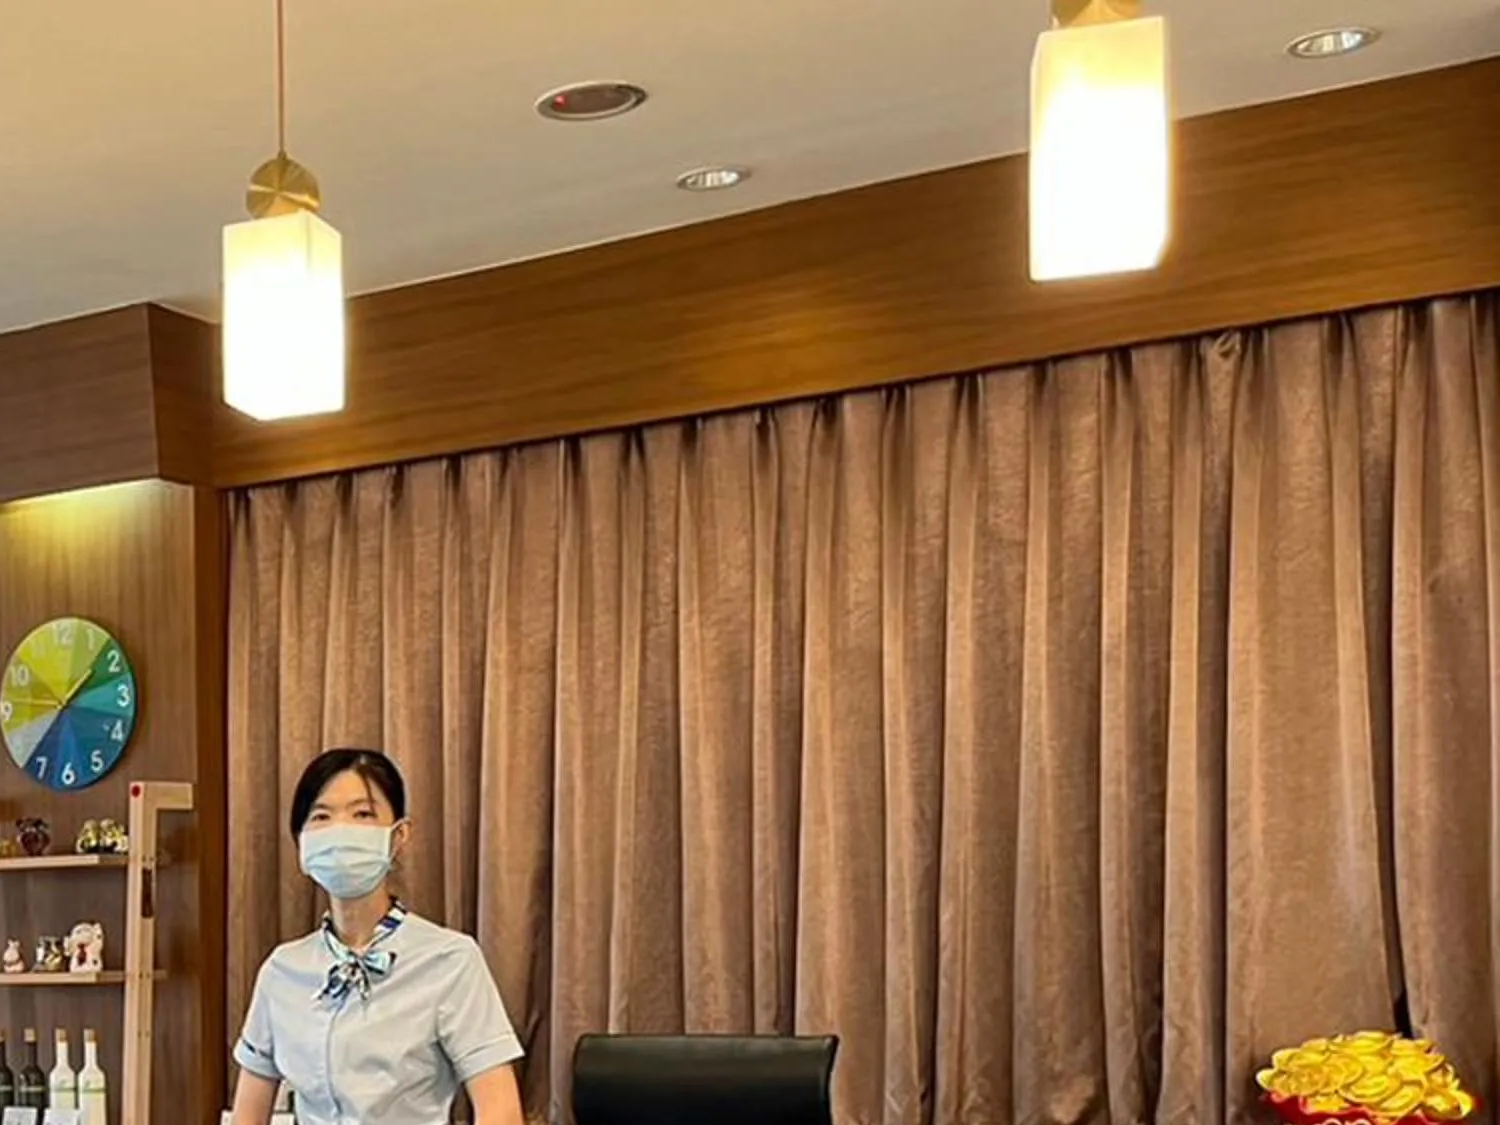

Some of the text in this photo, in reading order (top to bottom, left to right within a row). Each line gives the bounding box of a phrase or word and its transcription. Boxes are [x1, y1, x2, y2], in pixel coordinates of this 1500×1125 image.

[52, 622, 72, 645] 12
[86, 629, 94, 650] 1
[107, 650, 121, 673] 2
[9, 664, 30, 687] 10
[117, 684, 130, 707] 3
[1, 701, 13, 721] 9
[111, 720, 123, 741] 4
[36, 757, 48, 779] 7
[91, 750, 103, 773] 5
[62, 762, 75, 785] 6
